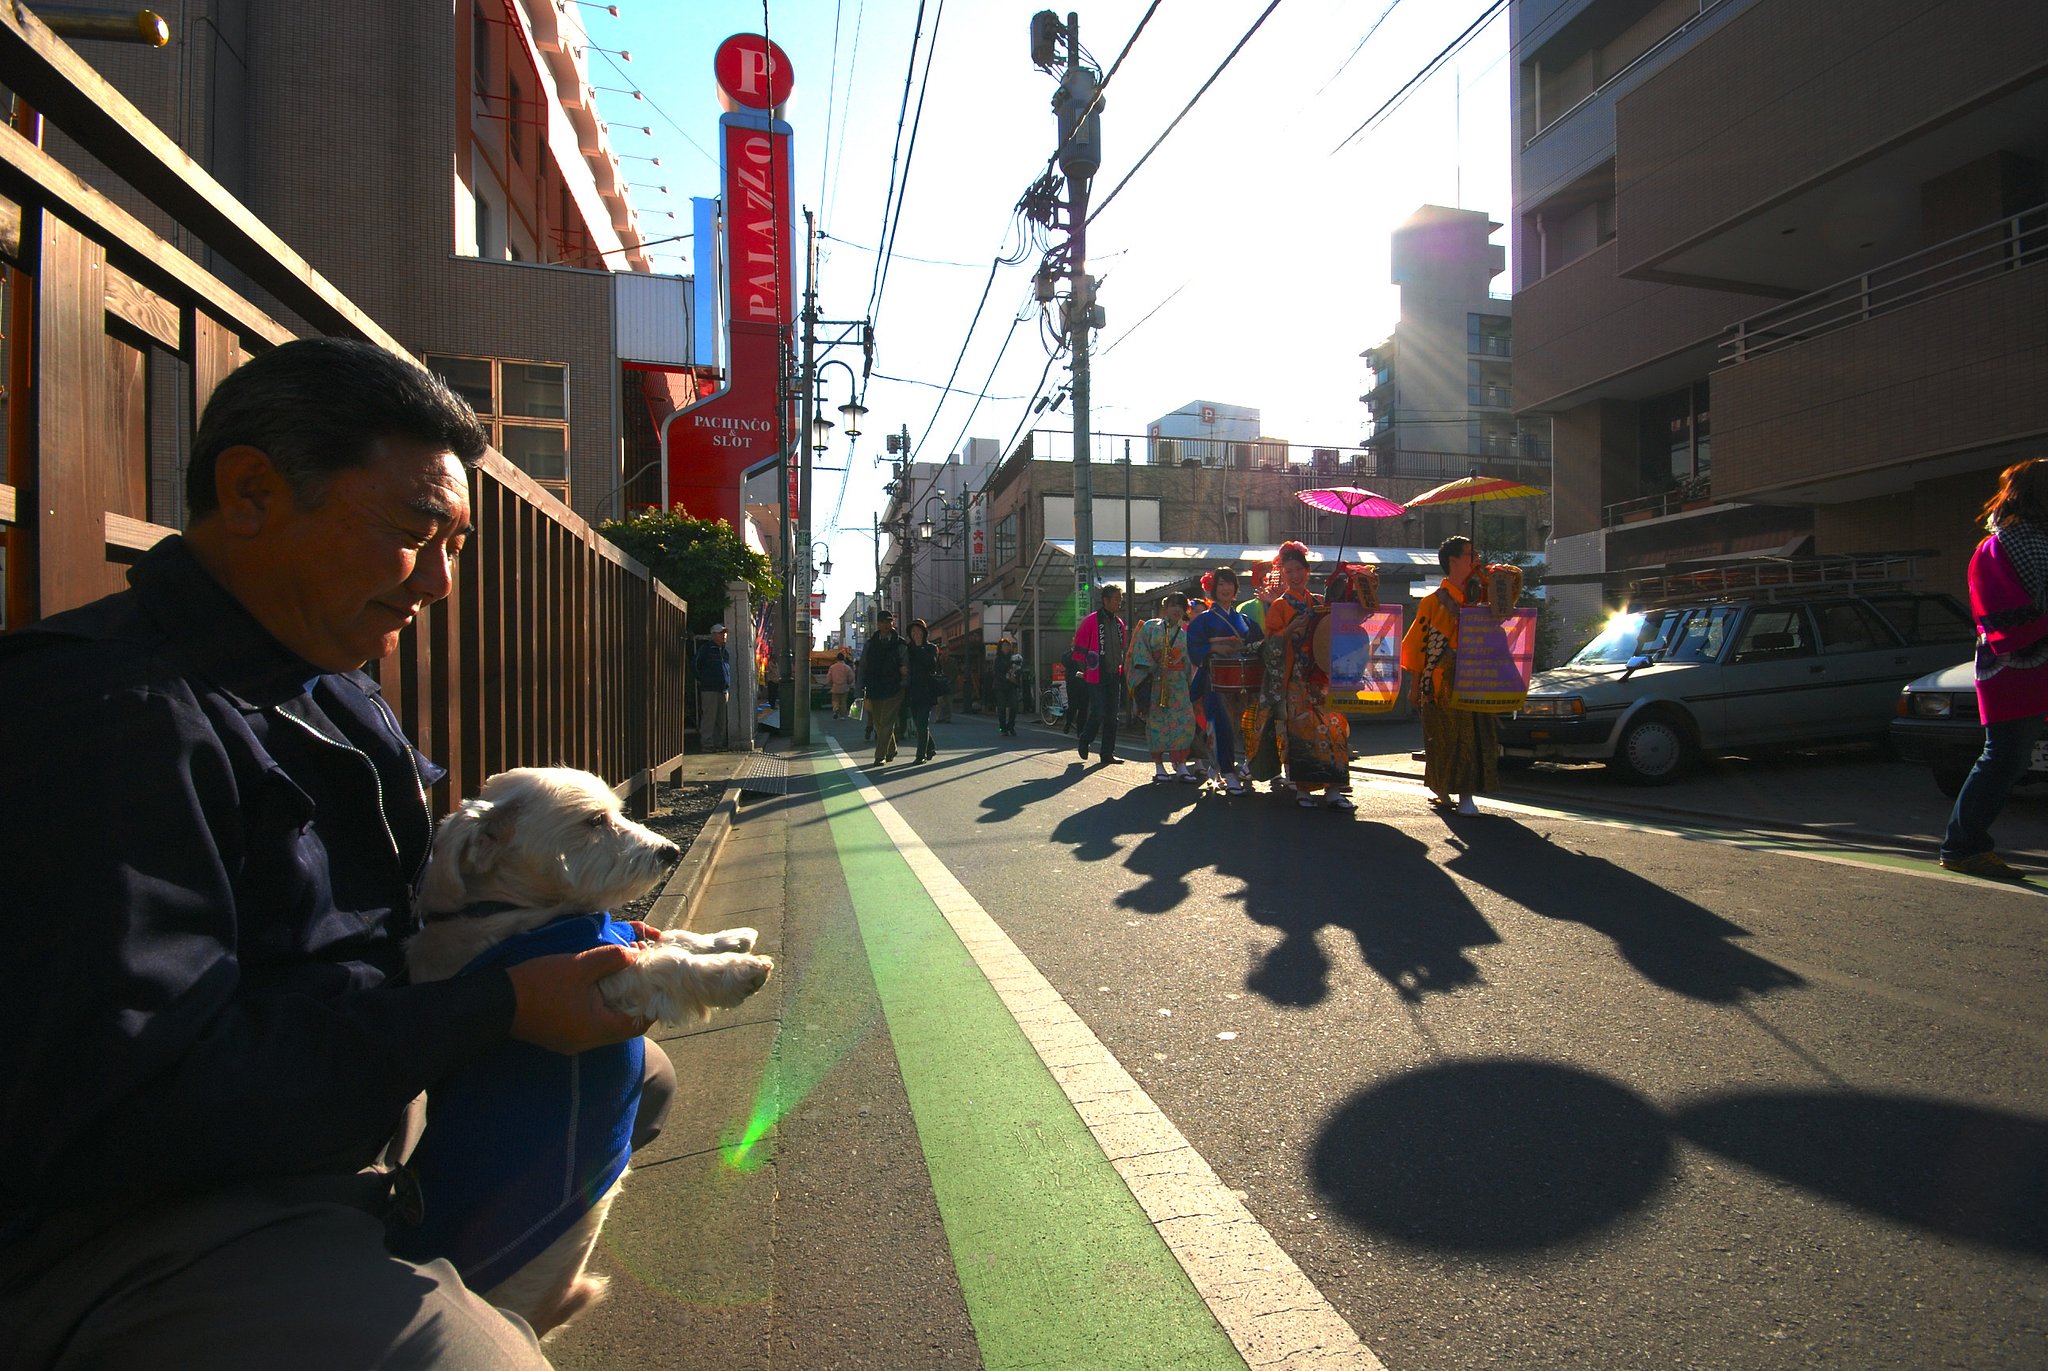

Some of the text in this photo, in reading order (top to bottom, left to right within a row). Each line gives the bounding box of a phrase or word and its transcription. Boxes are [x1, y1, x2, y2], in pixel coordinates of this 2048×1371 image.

[736, 47, 777, 95] P
[737, 137, 777, 319] PALAZZO
[694, 415, 771, 432] PACHINCO
[713, 435, 753, 448] SLOT
